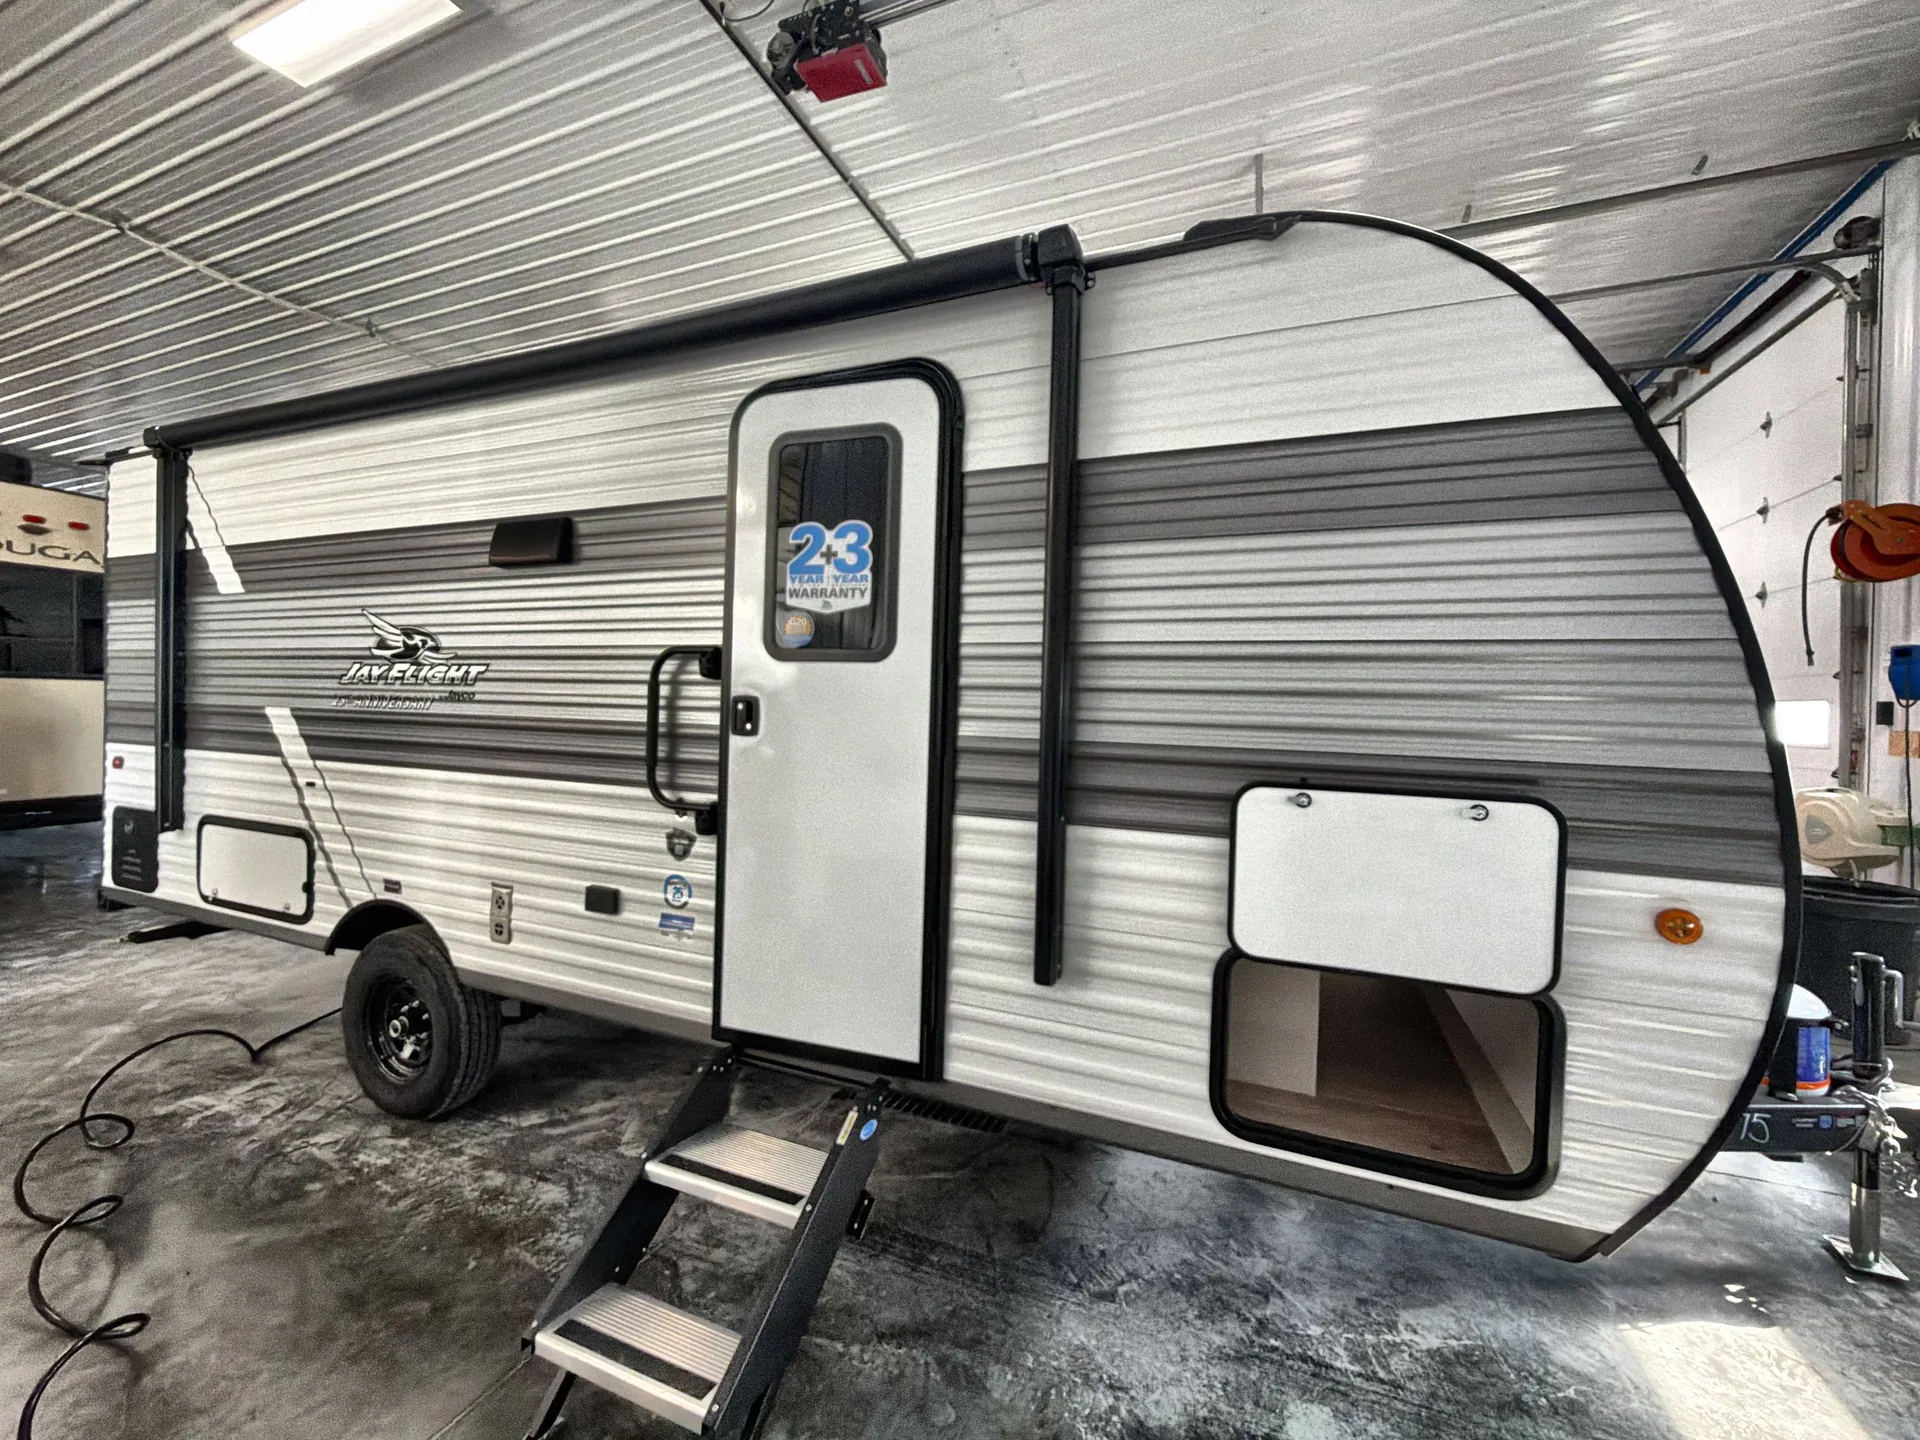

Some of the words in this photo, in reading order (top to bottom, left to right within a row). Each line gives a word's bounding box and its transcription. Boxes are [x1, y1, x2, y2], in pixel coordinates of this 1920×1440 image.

[0, 539, 101, 565] UGA
[789, 574, 824, 584] YEAR
[832, 574, 869, 584] YEAR
[788, 587, 868, 599] WARRANTY
[385, 662, 490, 686] FLIGHT
[1740, 1113, 1772, 1144] 15
